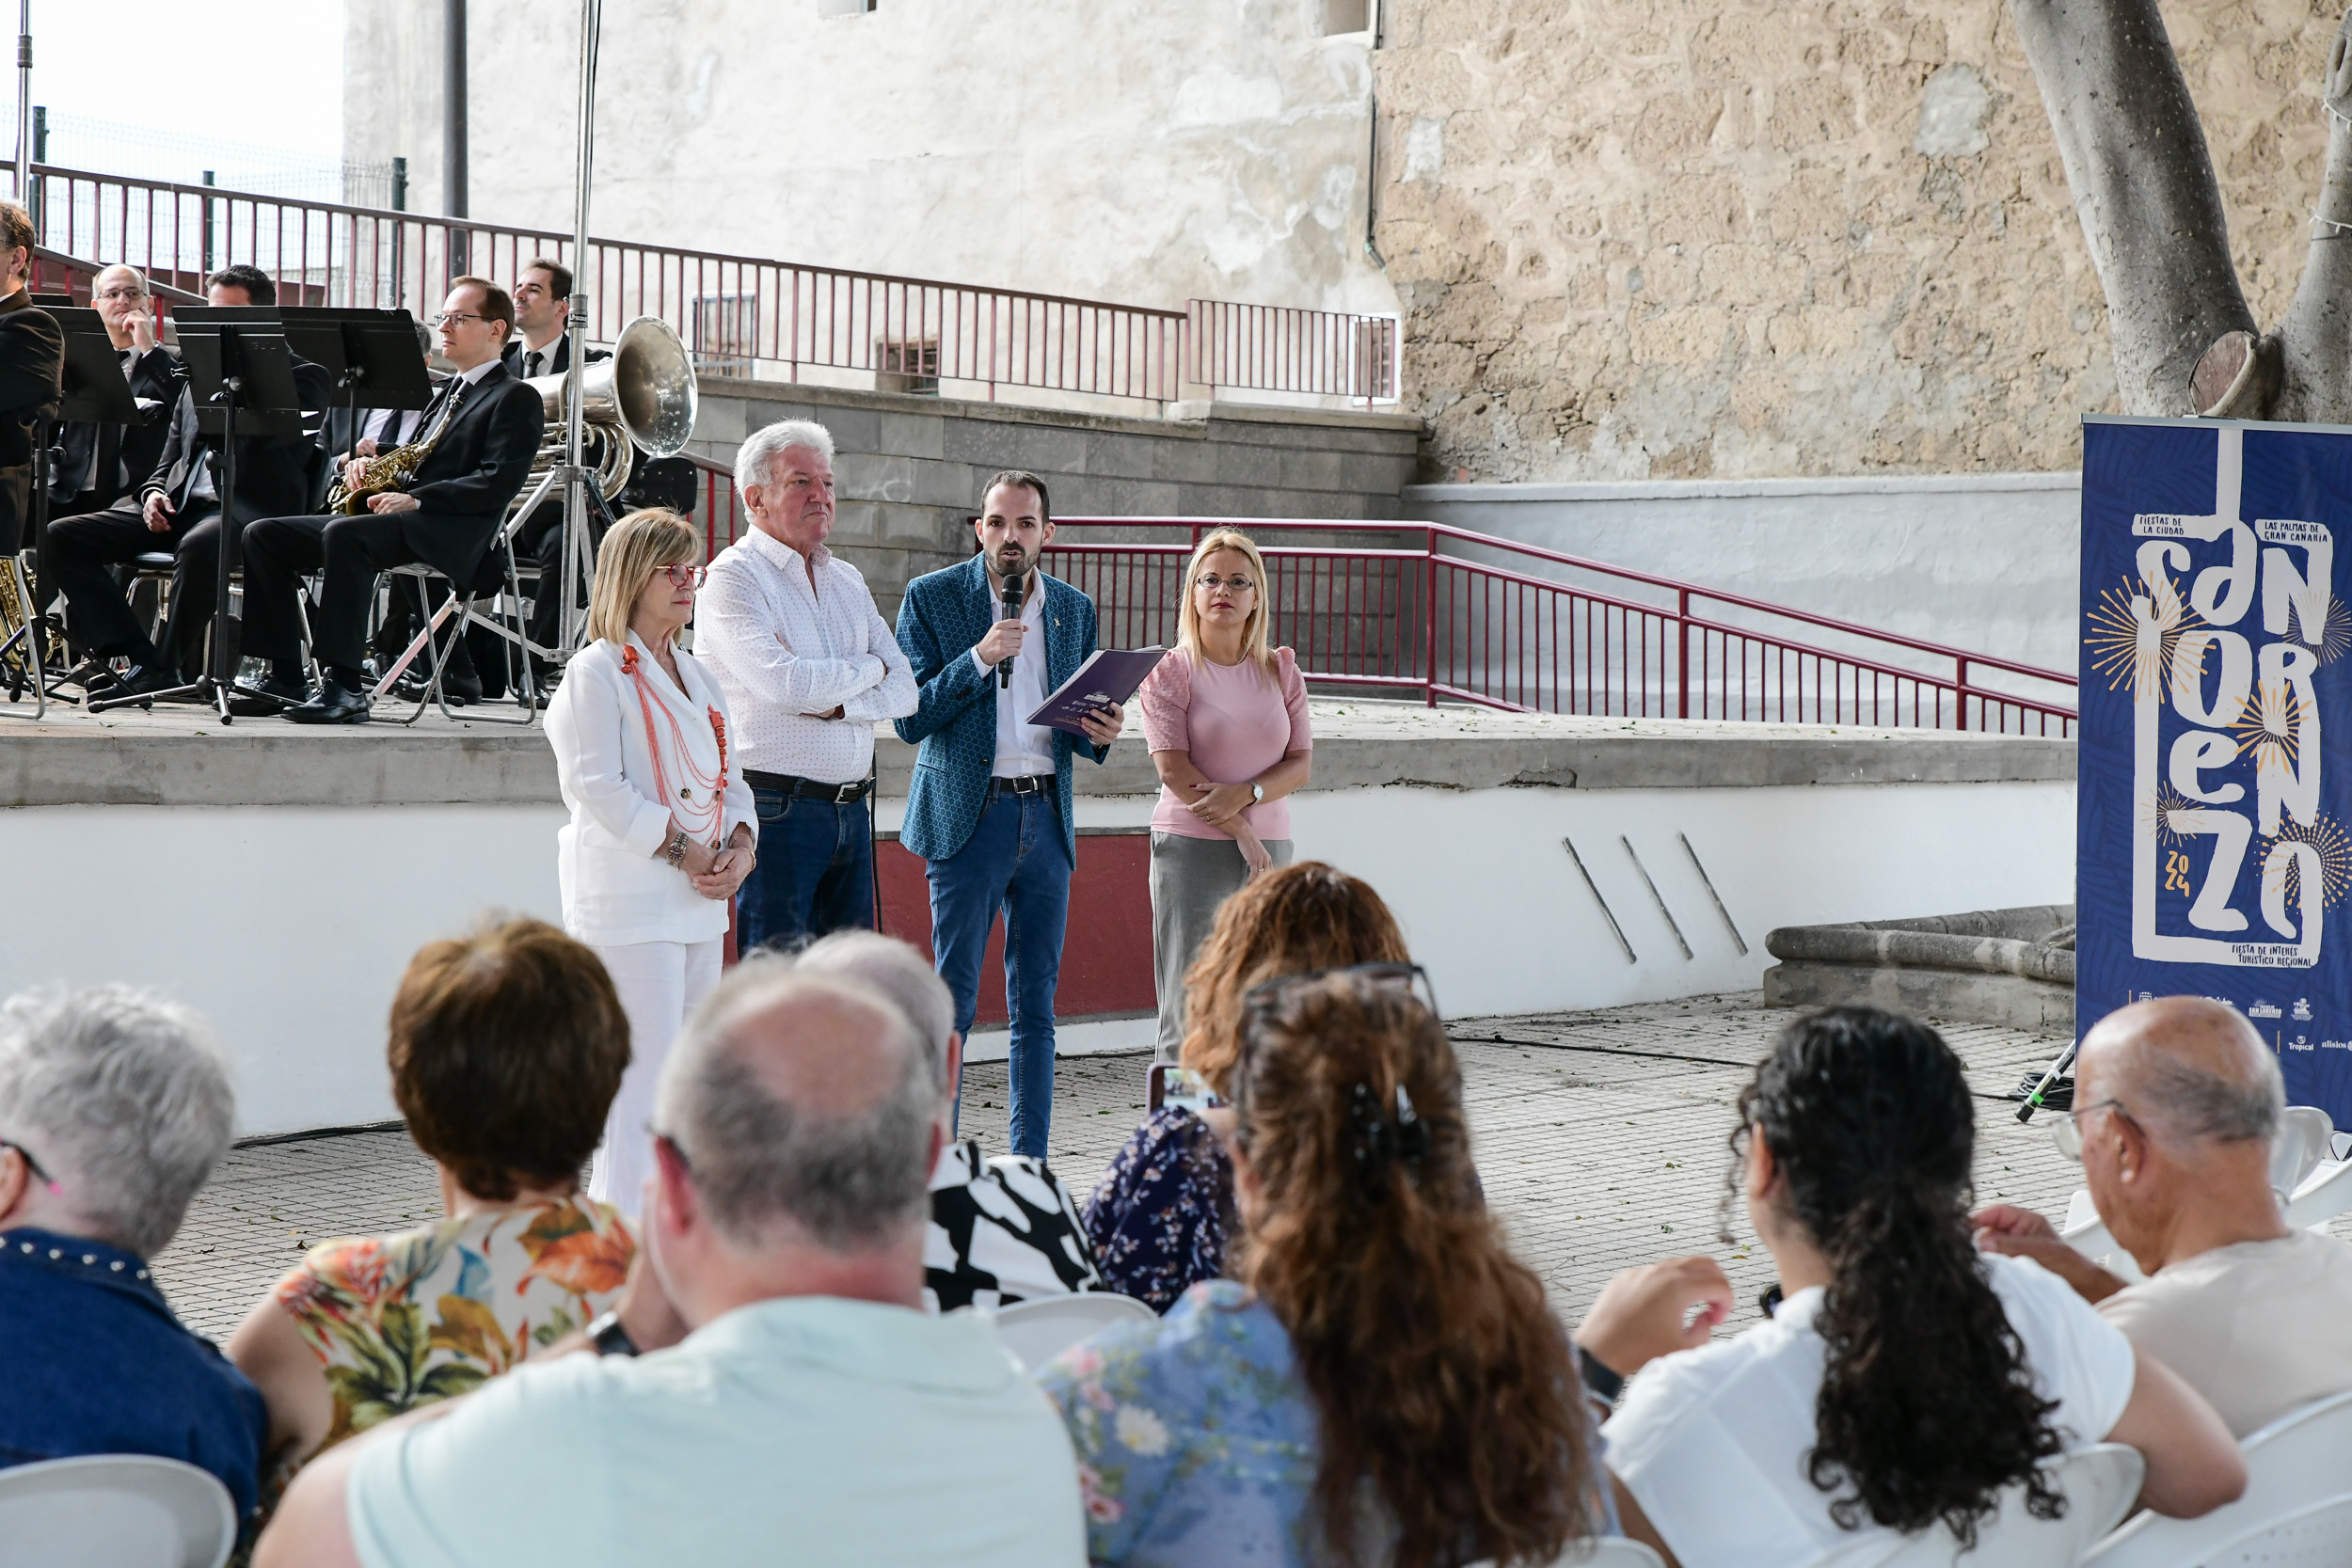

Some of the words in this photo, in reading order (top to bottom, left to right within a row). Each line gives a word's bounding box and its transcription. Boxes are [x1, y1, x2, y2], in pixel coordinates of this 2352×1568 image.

[2139, 515, 2169, 526] FIESTAS
[2172, 517, 2182, 527] DE
[2265, 521, 2278, 531] LAS
[2280, 522, 2308, 532] PALMAS
[2310, 524, 2319, 533] DE
[2143, 526, 2153, 534] LA
[2156, 526, 2185, 535] CIUDAD
[2265, 531, 2287, 541] GRAN
[2290, 532, 2328, 543] CANARIA
[2232, 943, 2255, 954] FIESTA
[2257, 945, 2267, 956] DE
[2269, 945, 2298, 957] INTERÉS
[2238, 952, 2274, 965] TURÍSTICO
[2277, 957, 2312, 969] REGIONAL
[2288, 1042, 2314, 1052] Tropical
